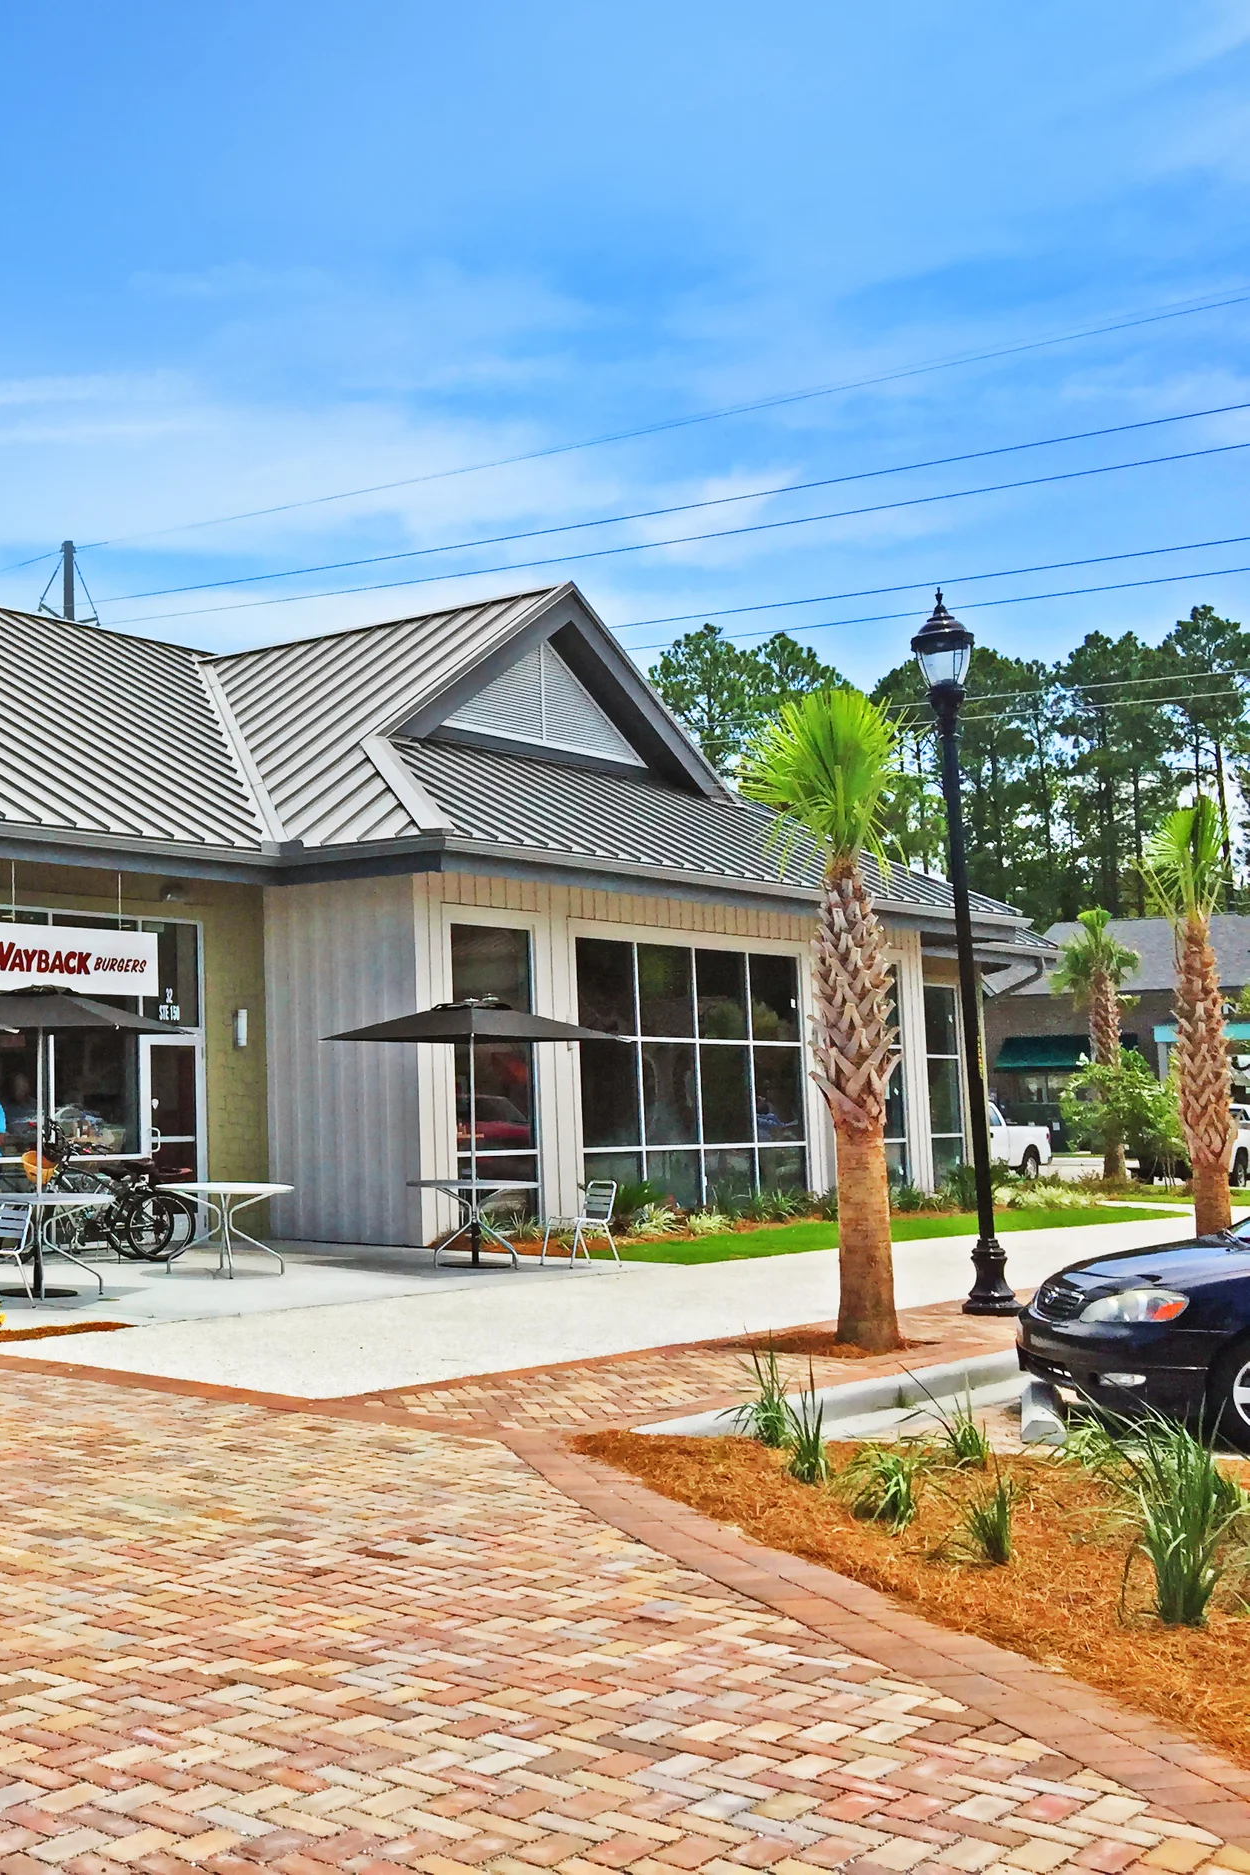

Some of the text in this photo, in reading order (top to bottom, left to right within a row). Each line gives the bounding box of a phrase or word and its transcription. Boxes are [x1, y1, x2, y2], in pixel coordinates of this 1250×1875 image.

[93, 957, 147, 973] BURGERS
[165, 987, 174, 1004] 32
[159, 1004, 169, 1021] STE
